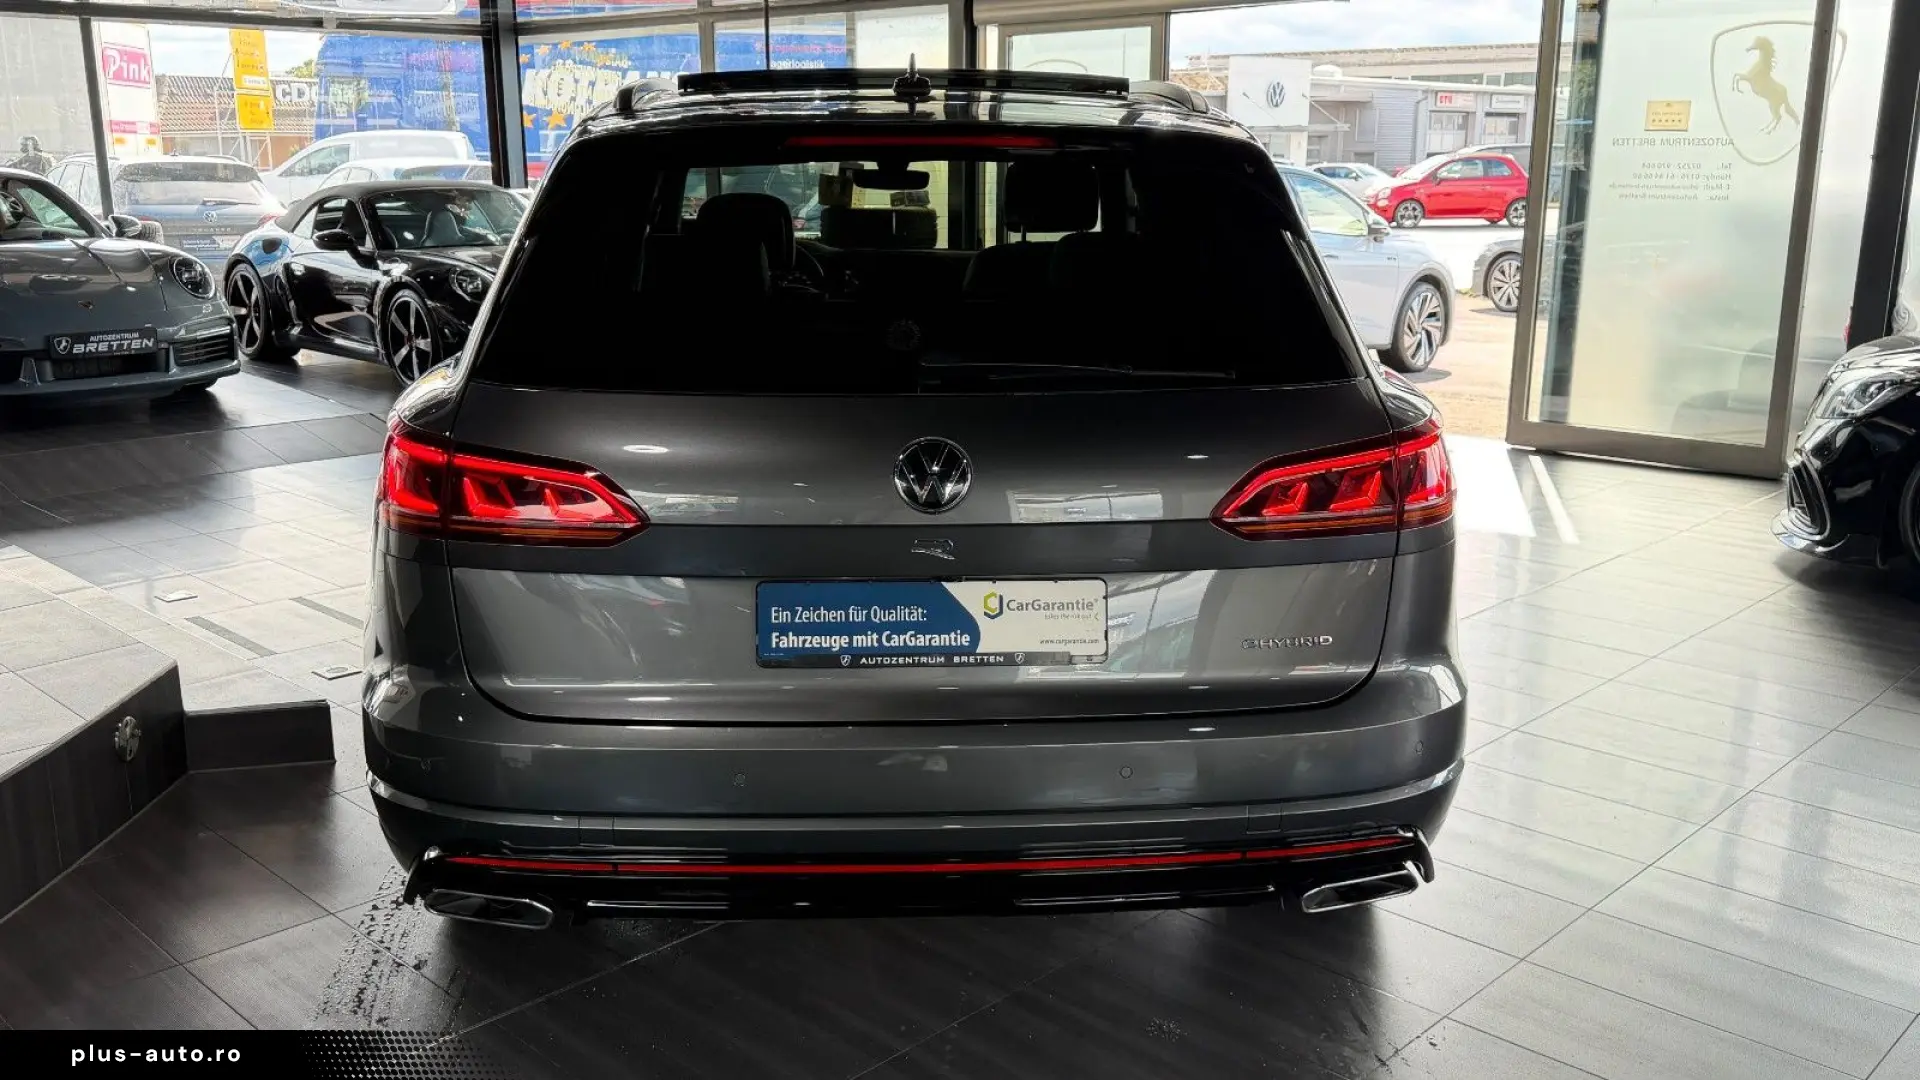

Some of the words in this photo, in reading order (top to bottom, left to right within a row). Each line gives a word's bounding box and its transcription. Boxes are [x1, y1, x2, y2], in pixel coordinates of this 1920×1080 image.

[104, 50, 151, 81] Pink
[89, 332, 139, 342] AUTOZENTRUM
[72, 338, 154, 354] BRETTEN
[893, 436, 973, 514] VW
[1006, 598, 1094, 611] CarGarantie
[771, 606, 791, 623] Ein
[794, 605, 845, 622] Zeichen
[848, 605, 868, 622] für
[870, 605, 927, 623] Qualität:
[771, 631, 849, 651] Fahrzeuge
[852, 631, 879, 647] mit
[881, 630, 971, 647] CarGarantie
[860, 656, 945, 664] AUTOZENTRUM
[953, 655, 1004, 664] BRETTEN
